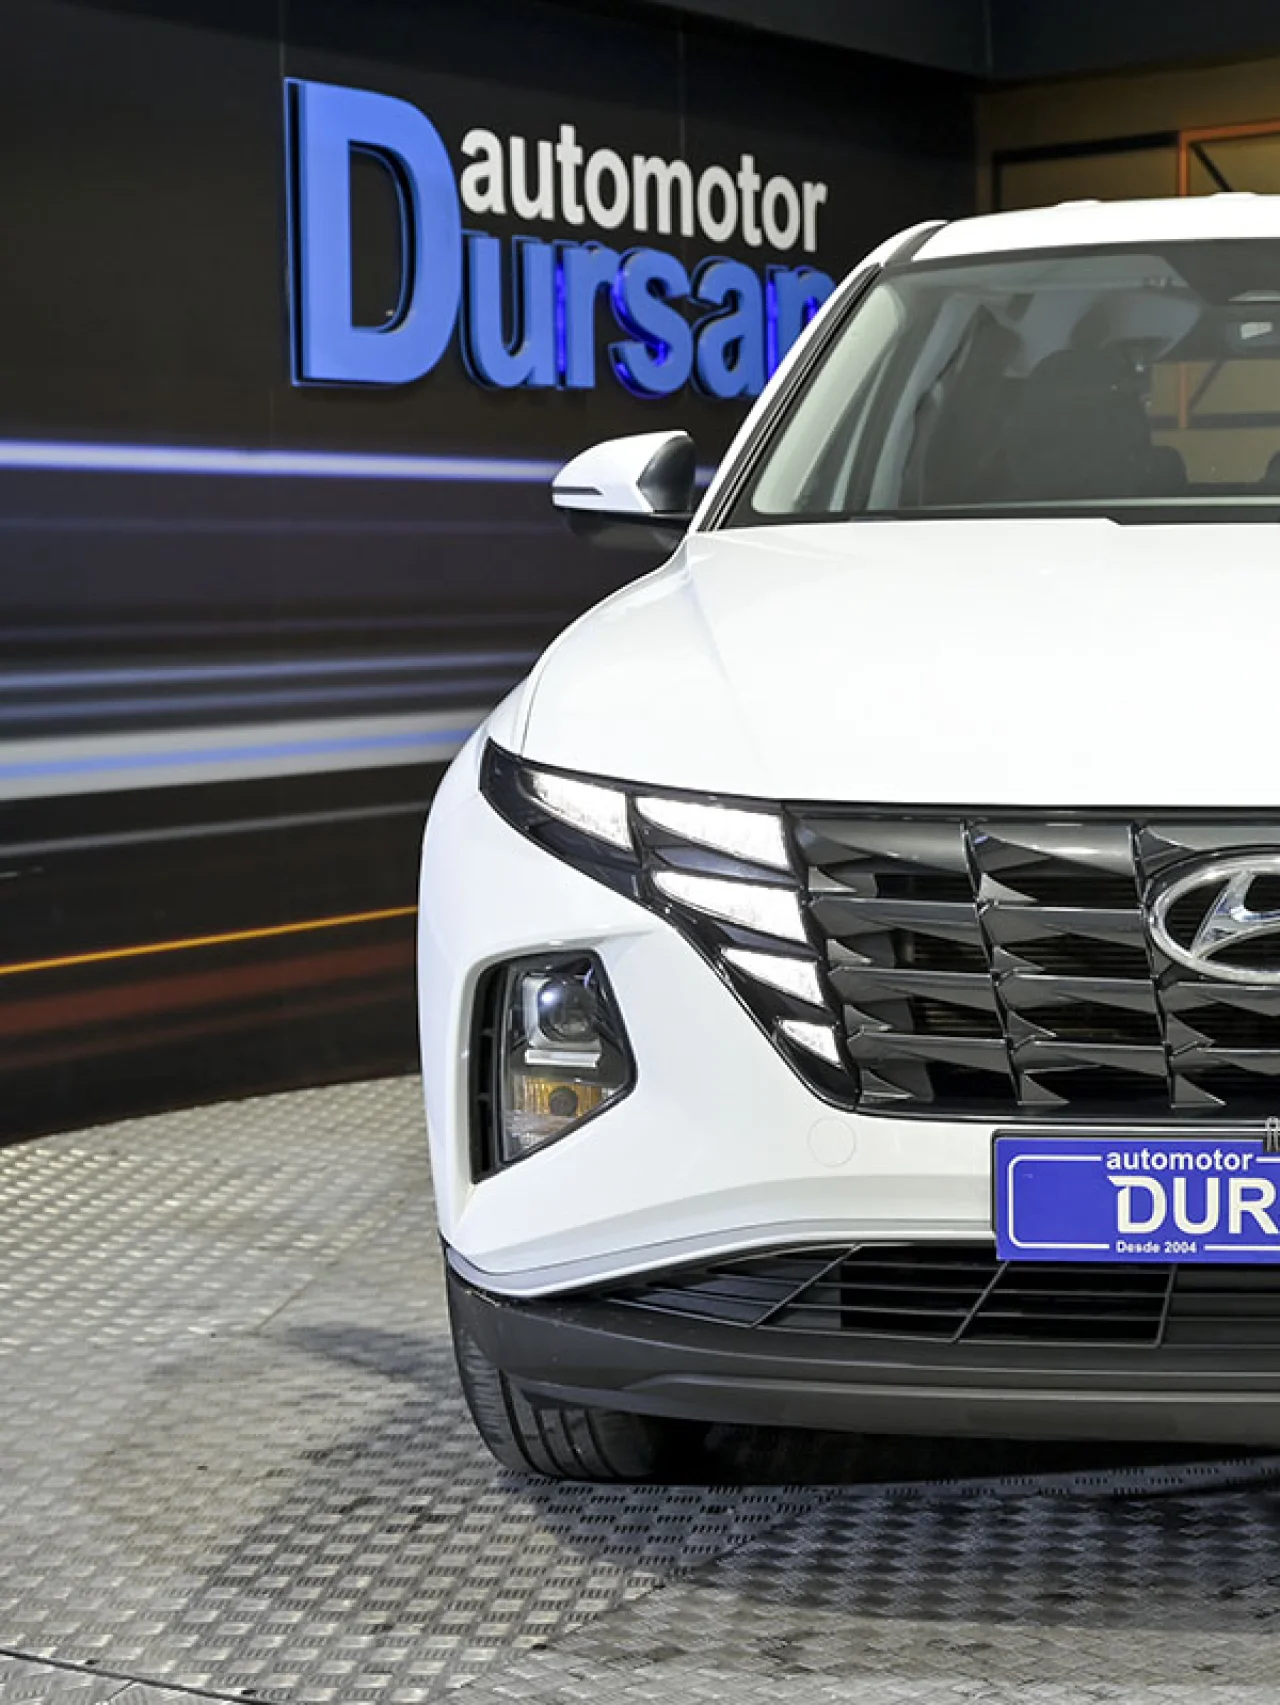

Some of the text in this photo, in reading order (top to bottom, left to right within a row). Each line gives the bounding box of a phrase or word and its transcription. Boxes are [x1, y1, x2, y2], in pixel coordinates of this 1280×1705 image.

[460, 123, 828, 252] automotor
[1106, 1149, 1254, 1171] automotor
[1116, 1240, 1198, 1255] Desde 2004
